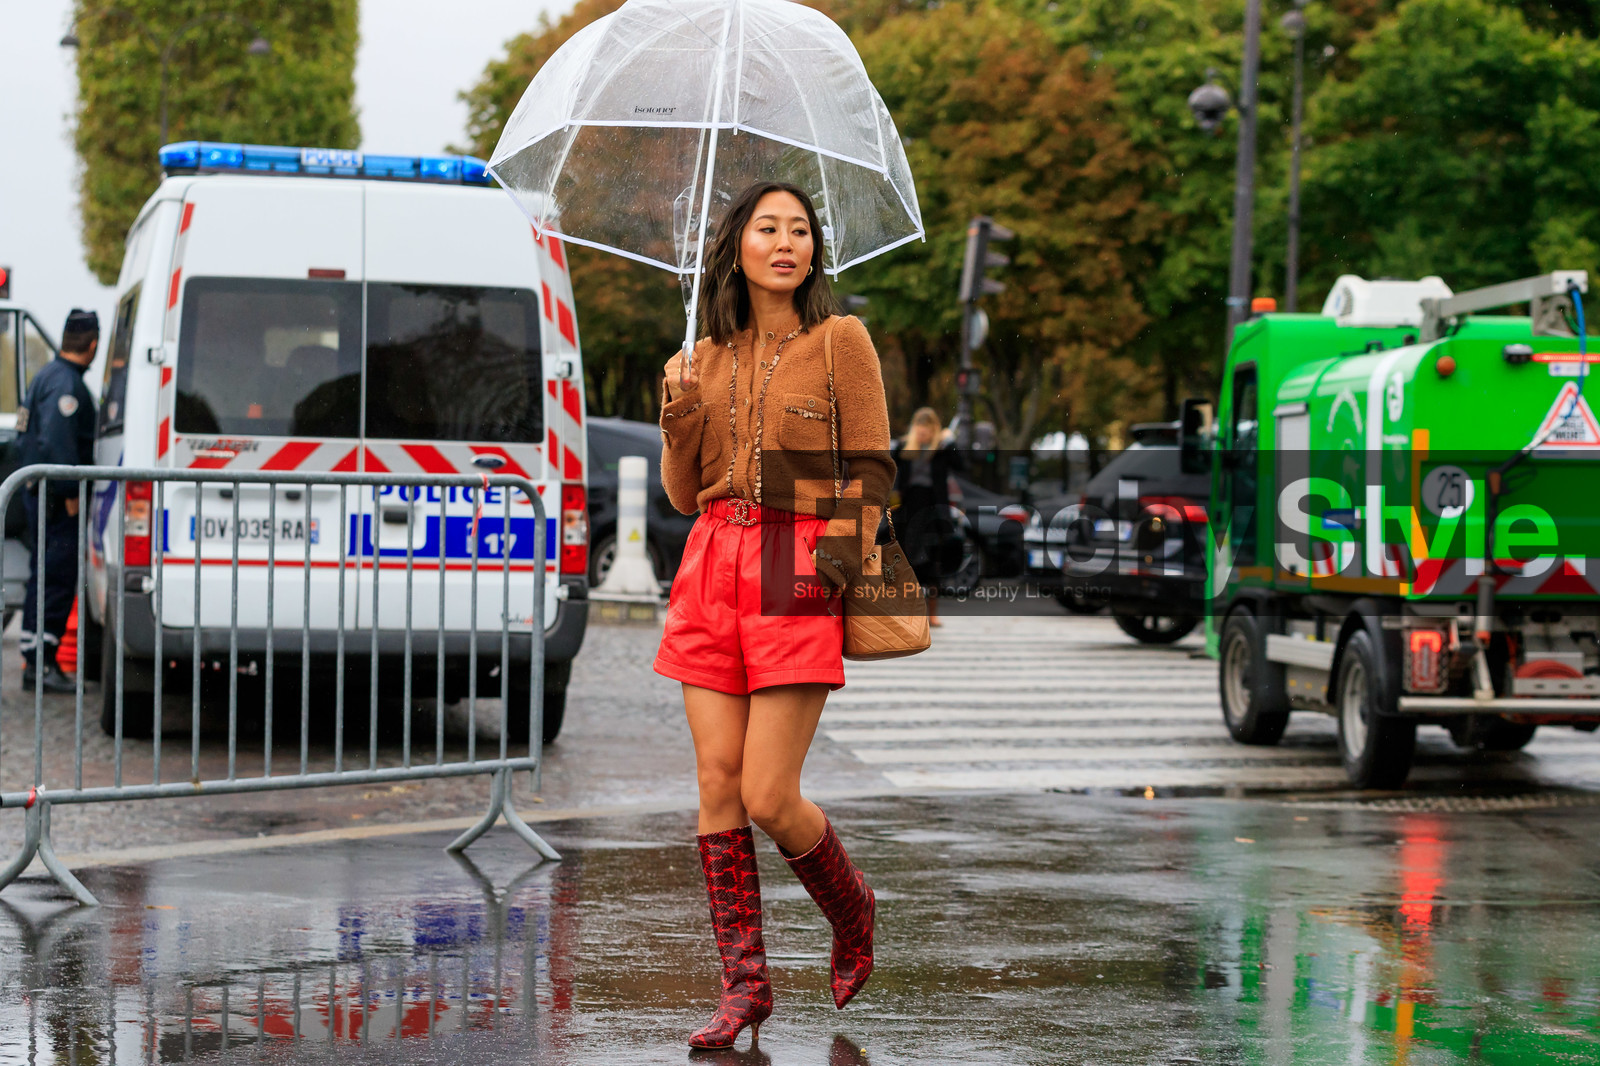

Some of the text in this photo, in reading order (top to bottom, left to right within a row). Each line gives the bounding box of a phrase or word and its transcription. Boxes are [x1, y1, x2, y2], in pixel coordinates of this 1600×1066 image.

[634, 105, 677, 113] isotoner
[372, 484, 503, 504] POLICE
[1437, 472, 1462, 509] 25
[484, 532, 518, 555] 17
